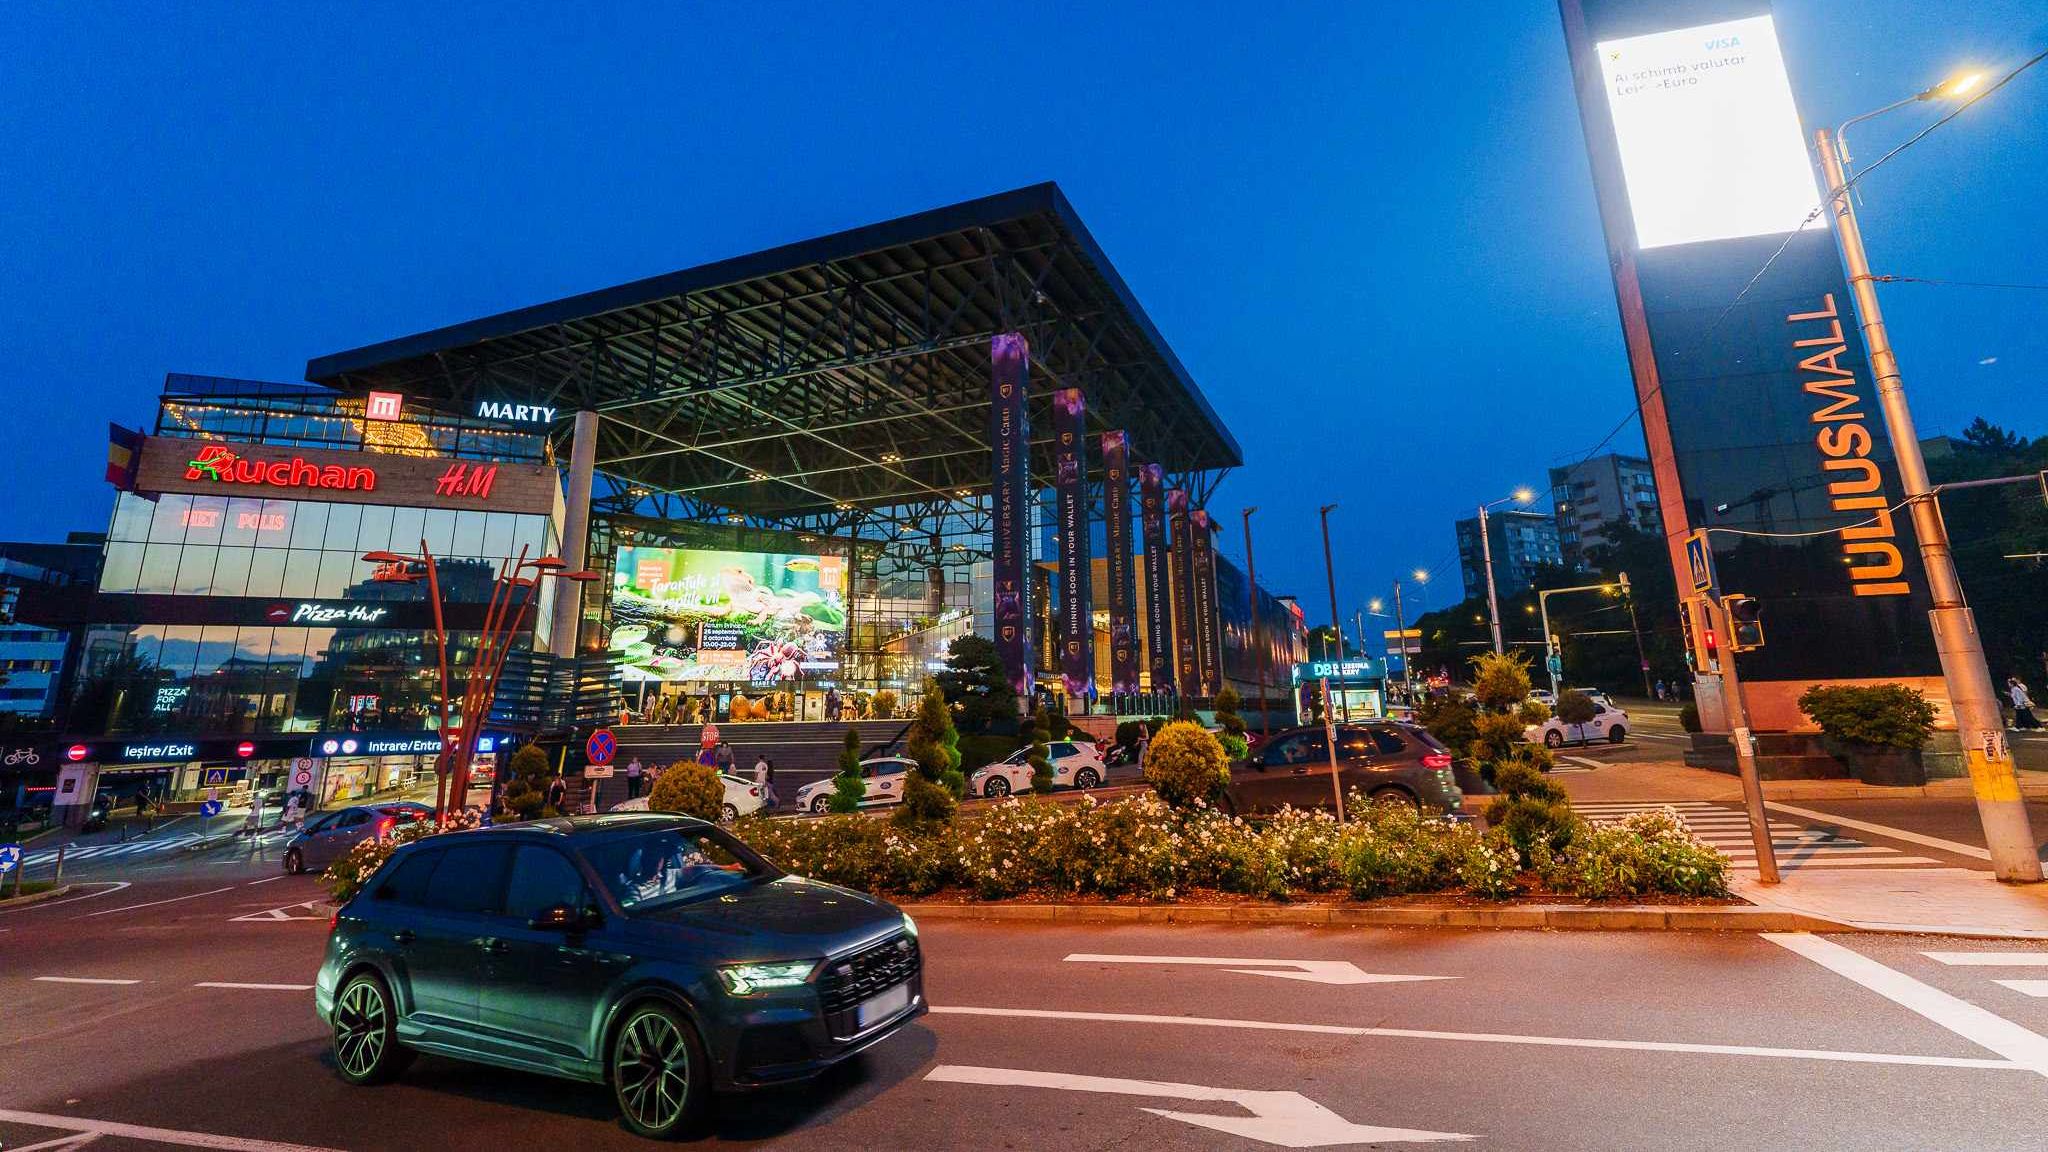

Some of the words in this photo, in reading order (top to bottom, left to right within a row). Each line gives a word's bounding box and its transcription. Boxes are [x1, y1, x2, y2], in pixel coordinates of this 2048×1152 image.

[1705, 36, 1741, 50] VISA
[1632, 64, 1687, 81] schimb
[1690, 55, 1746, 71] valutar
[478, 401, 556, 423] MARTY
[184, 445, 376, 491] Auchan
[435, 463, 498, 499] H&M
[1066, 493, 1075, 529] WALLET
[1002, 481, 1012, 567] ANNIVERSARY
[1067, 530, 1076, 555] YOUR
[1068, 556, 1076, 567] IN
[1069, 568, 1078, 595] SOON
[1153, 593, 1159, 601] IN
[293, 604, 345, 623] Pizza
[346, 605, 387, 622] Hut
[1070, 596, 1079, 635] SHINING
[1314, 663, 1333, 676] DB
[158, 688, 187, 696] PIZZA
[153, 703, 171, 711] ALL
[702, 731, 719, 742] STOP
